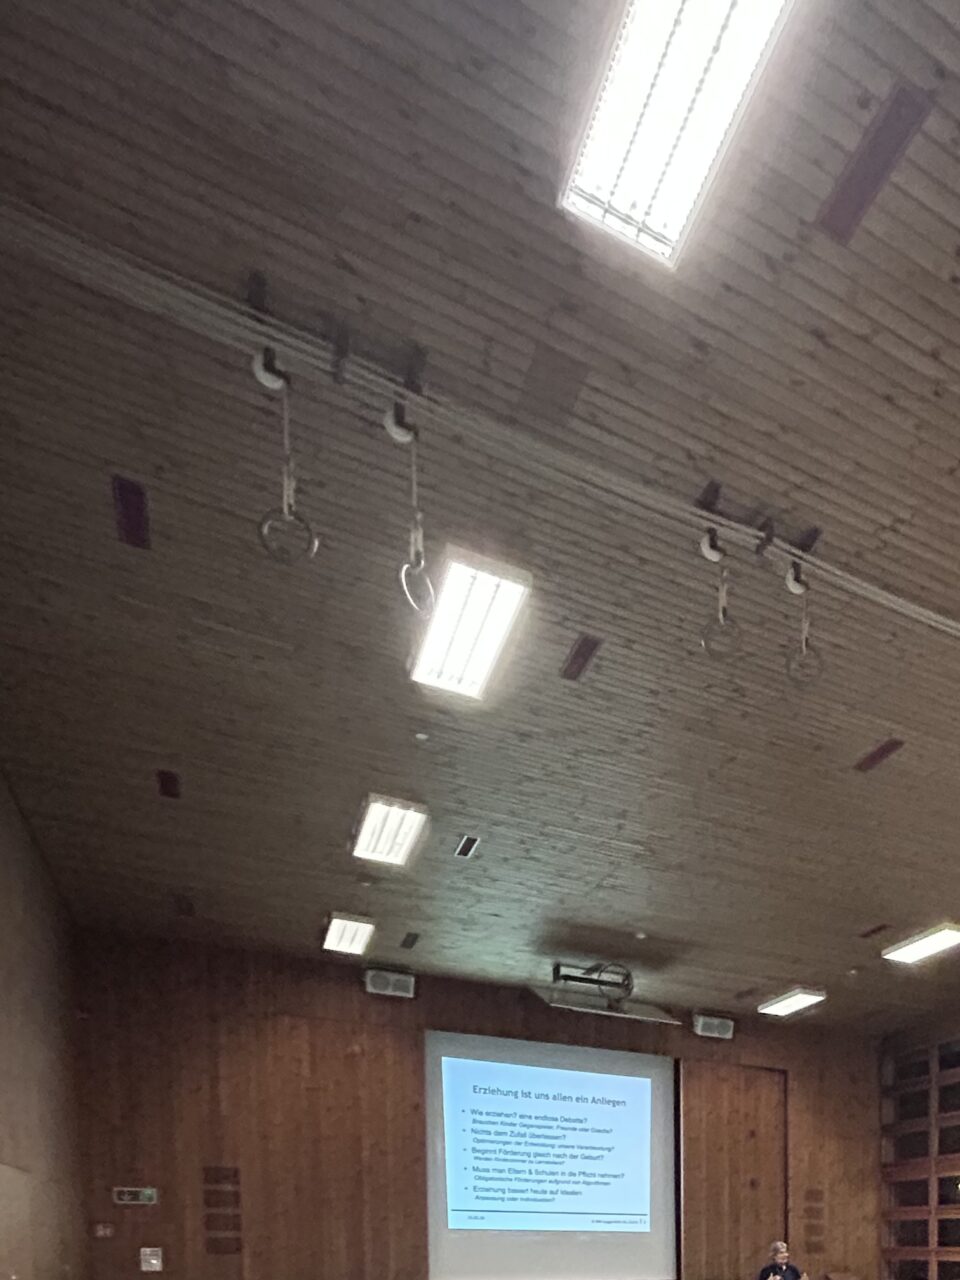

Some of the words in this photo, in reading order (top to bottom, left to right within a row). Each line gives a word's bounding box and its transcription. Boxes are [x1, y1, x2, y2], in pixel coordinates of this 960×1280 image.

[473, 1084, 518, 1099] Erziehung
[521, 1089, 532, 1099] ist
[535, 1092, 550, 1100] uns
[552, 1092, 573, 1102] allen
[575, 1095, 588, 1103] ein
[591, 1095, 626, 1107] Anliegen
[470, 1108, 483, 1116] Wie
[485, 1110, 517, 1118] erziehen?
[560, 1115, 587, 1124] Debatte?
[471, 1127, 492, 1135] Nichts
[509, 1129, 527, 1138] Zufall
[471, 1146, 497, 1155] Beginnt
[498, 1147, 531, 1158] Förderung
[580, 1152, 604, 1160] Geburt?
[472, 1165, 490, 1173] Muss
[535, 1168, 559, 1176] Schulen
[578, 1170, 596, 1178] Pflicht
[473, 1184, 506, 1195] Erziehung
[530, 1187, 547, 1195] heute
